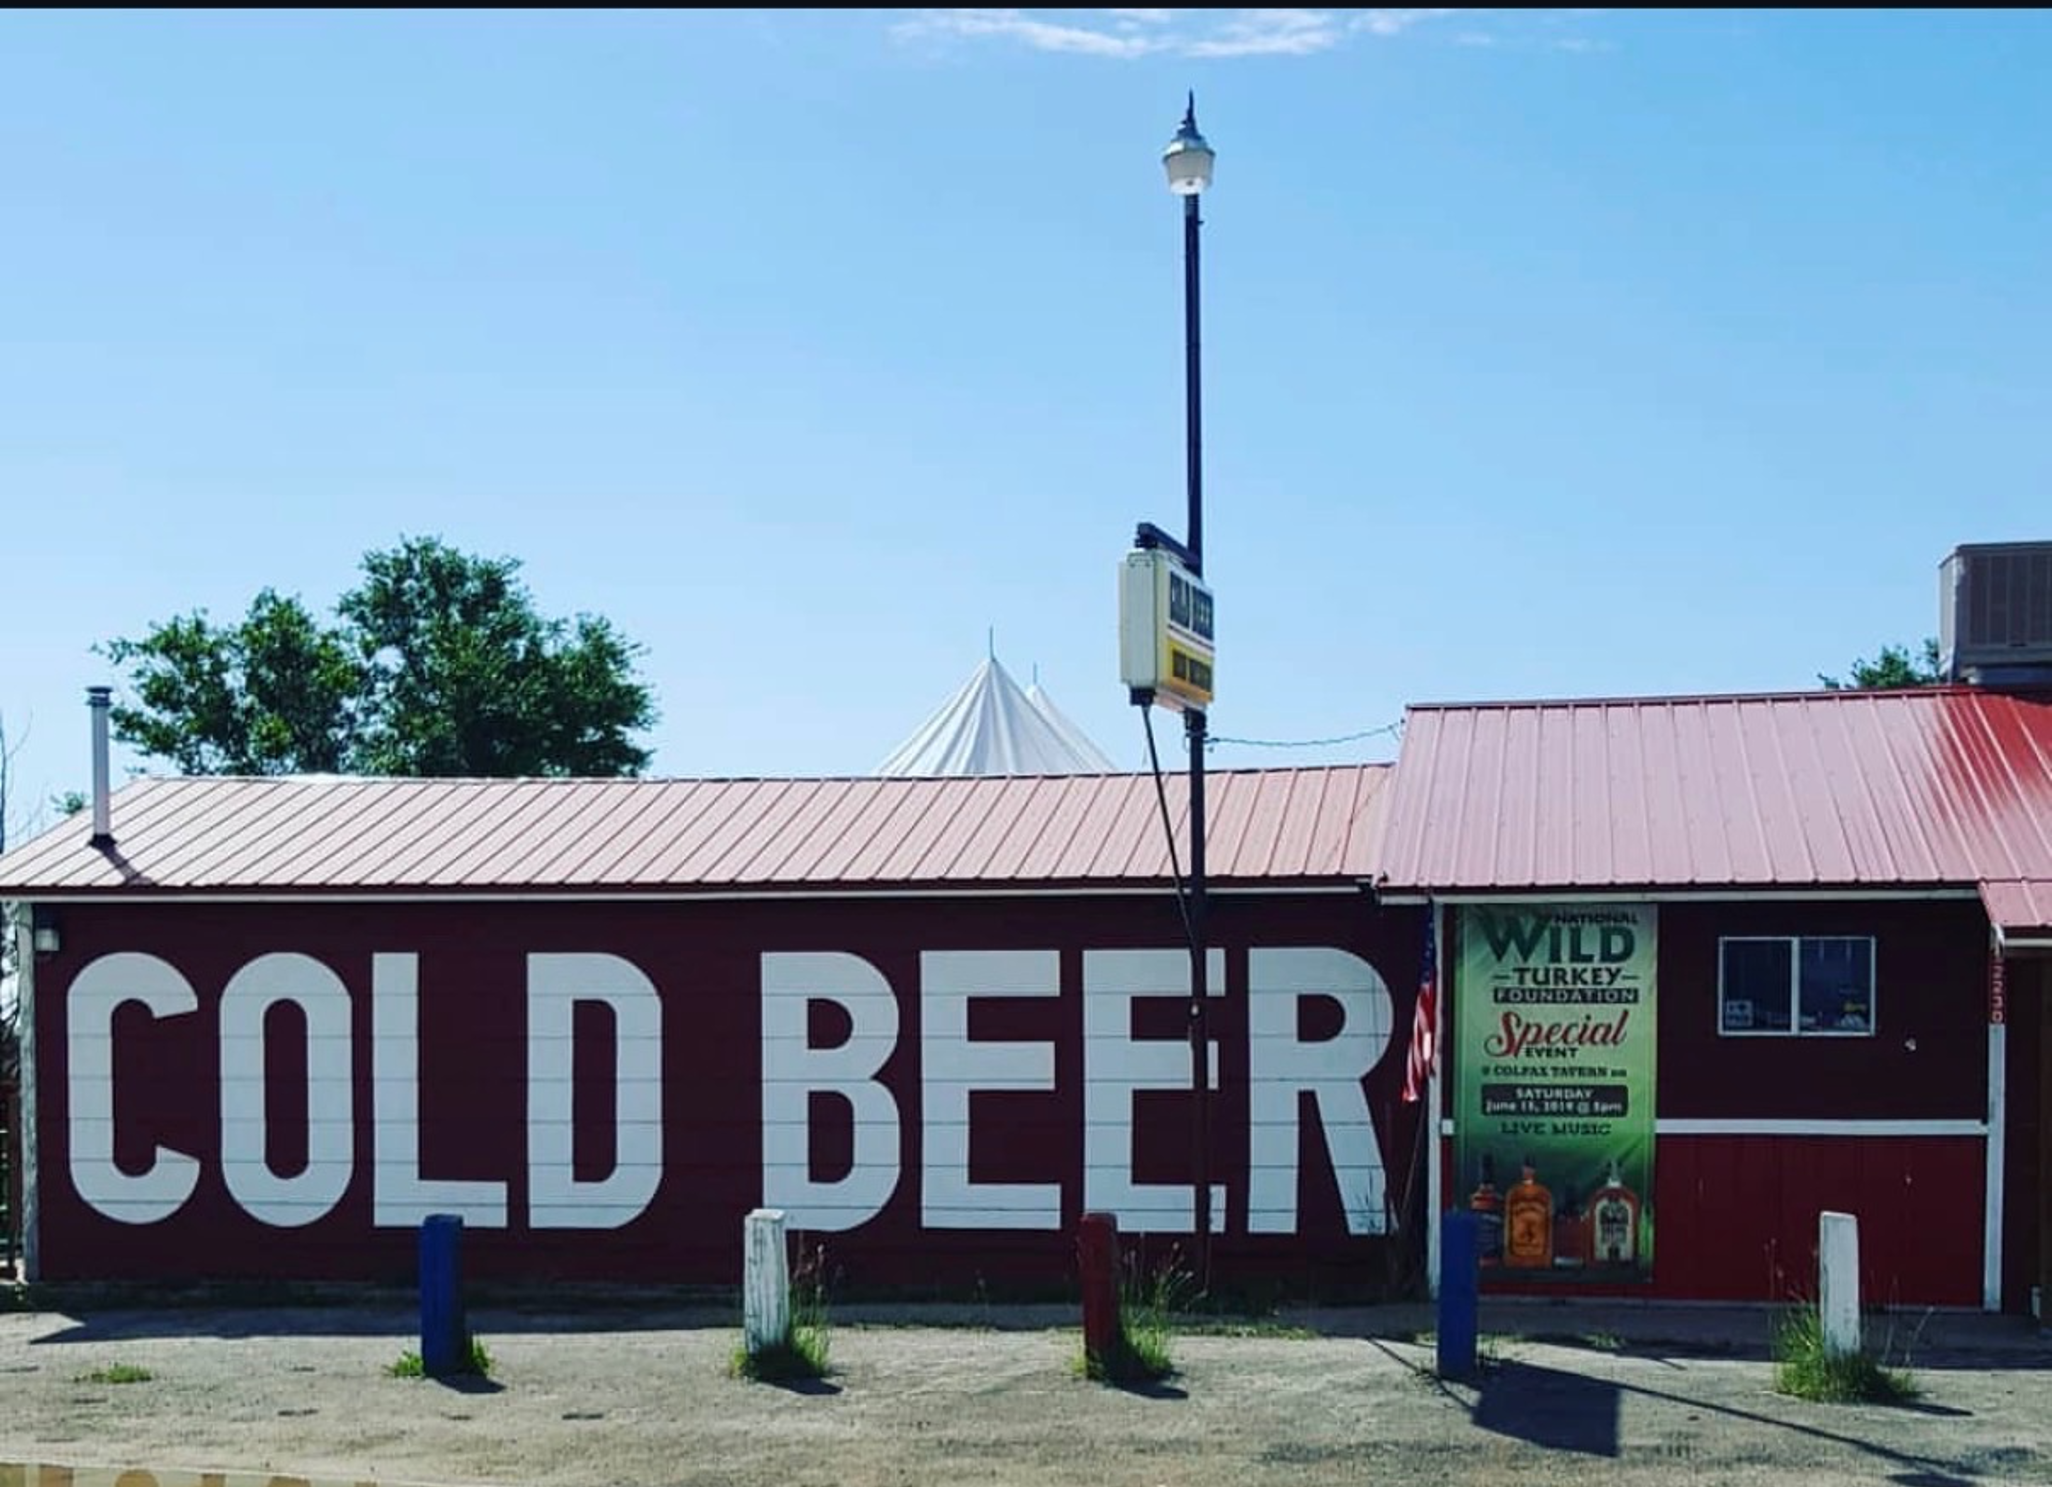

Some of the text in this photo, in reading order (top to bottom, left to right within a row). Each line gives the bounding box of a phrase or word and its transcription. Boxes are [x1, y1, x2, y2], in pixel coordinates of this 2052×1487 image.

[1478, 906, 1635, 964] WILD
[1512, 968, 1622, 986] TURKEY
[1497, 989, 1635, 1002] FOUNDATION
[1484, 1009, 1629, 1058] Special
[1525, 1048, 1579, 1058] EVENT
[1494, 1066, 1548, 1077] COLFAX
[1551, 1066, 1608, 1077] TAVERN
[67, 947, 1394, 1235] COLD BEER
[1516, 1088, 1594, 1100] SATURDAY
[1486, 1099, 1516, 1113] June
[1501, 1123, 1612, 1135] LIVE MUSIC
